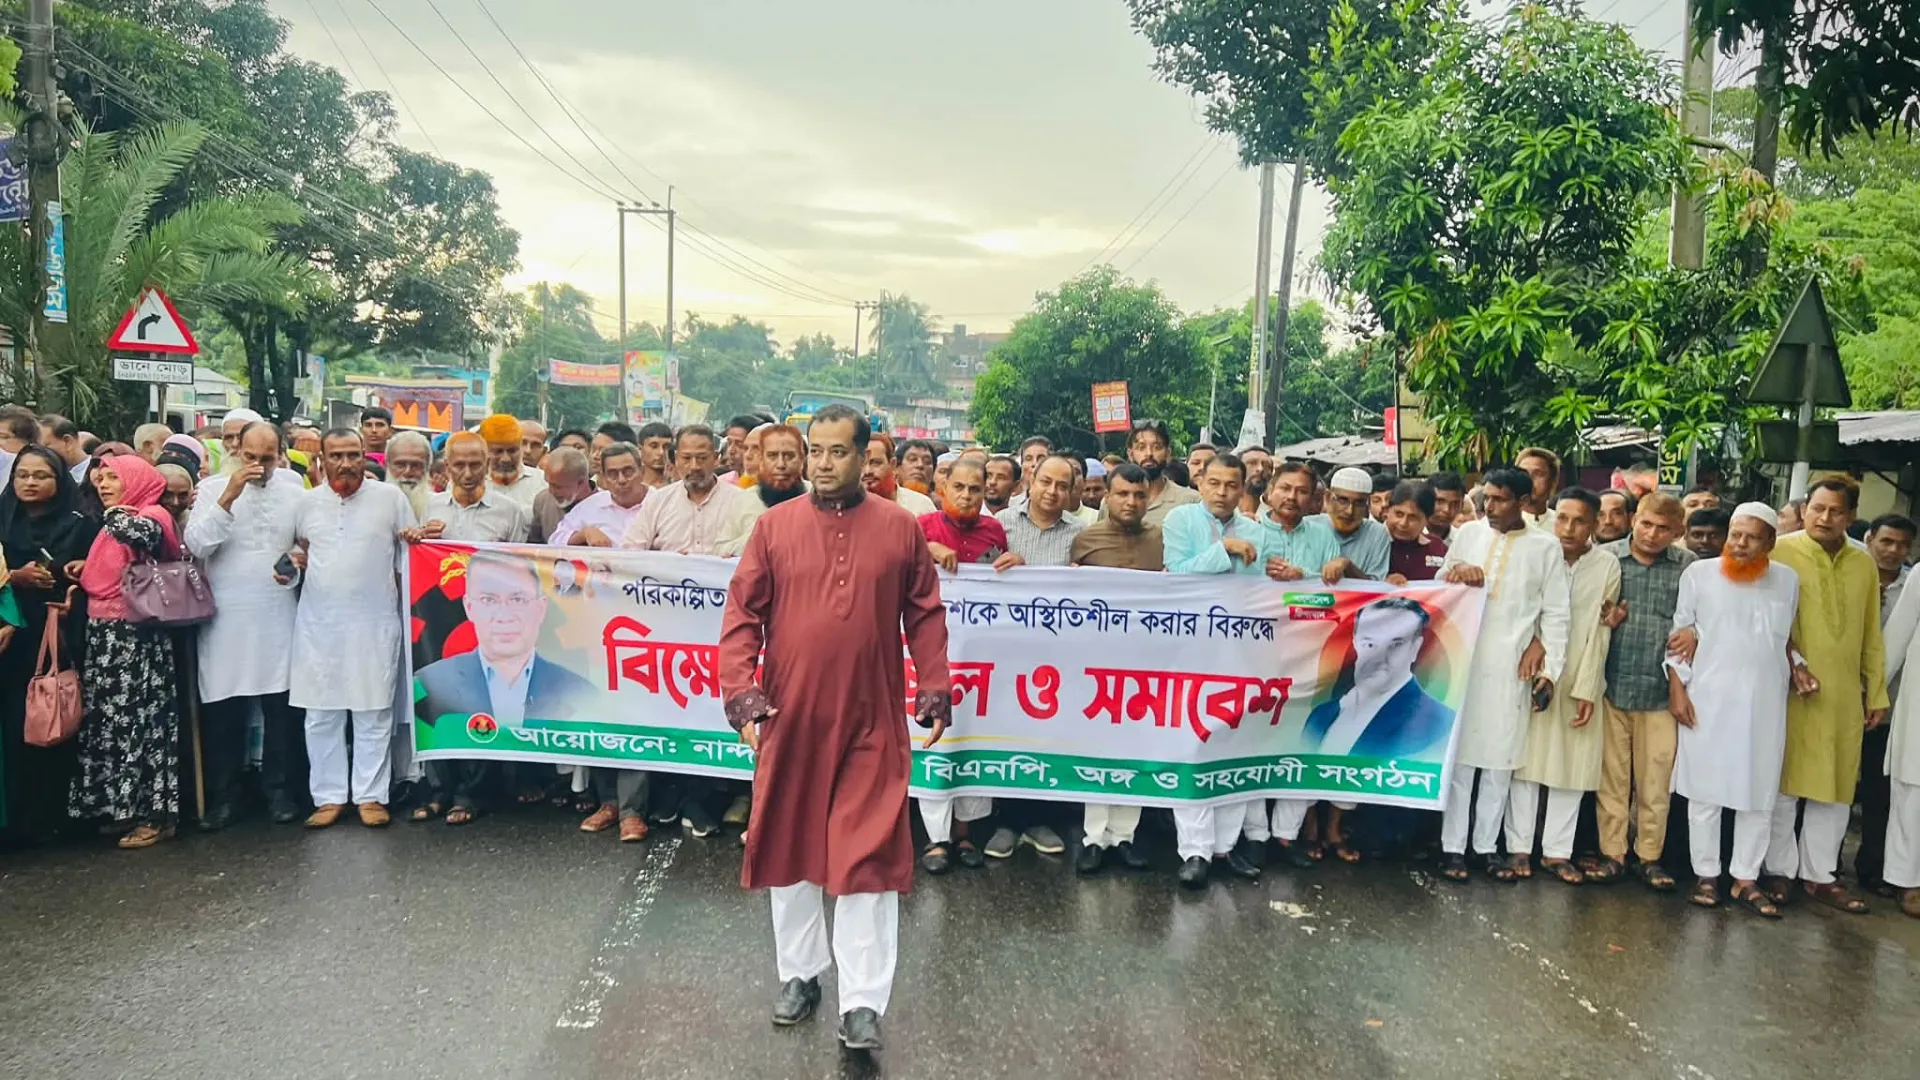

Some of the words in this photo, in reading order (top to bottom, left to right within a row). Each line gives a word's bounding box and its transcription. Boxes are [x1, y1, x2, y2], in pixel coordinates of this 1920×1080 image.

[943, 598, 1001, 626] শকে
[1007, 596, 1131, 636] অস্থিতিশীল
[1139, 608, 1200, 637] করার
[1207, 605, 1278, 642] বিরুদ্ধে
[1016, 664, 1061, 720] ও
[1082, 668, 1292, 743] সমাবেশ
[689, 739, 755, 764] নান্দ
[920, 755, 1058, 787] বিএনপি,
[1073, 765, 1139, 788] অঙ্গ
[1151, 771, 1179, 789] ও
[1193, 757, 1308, 791] সহযোগী
[1316, 760, 1437, 794] সংগঠন
